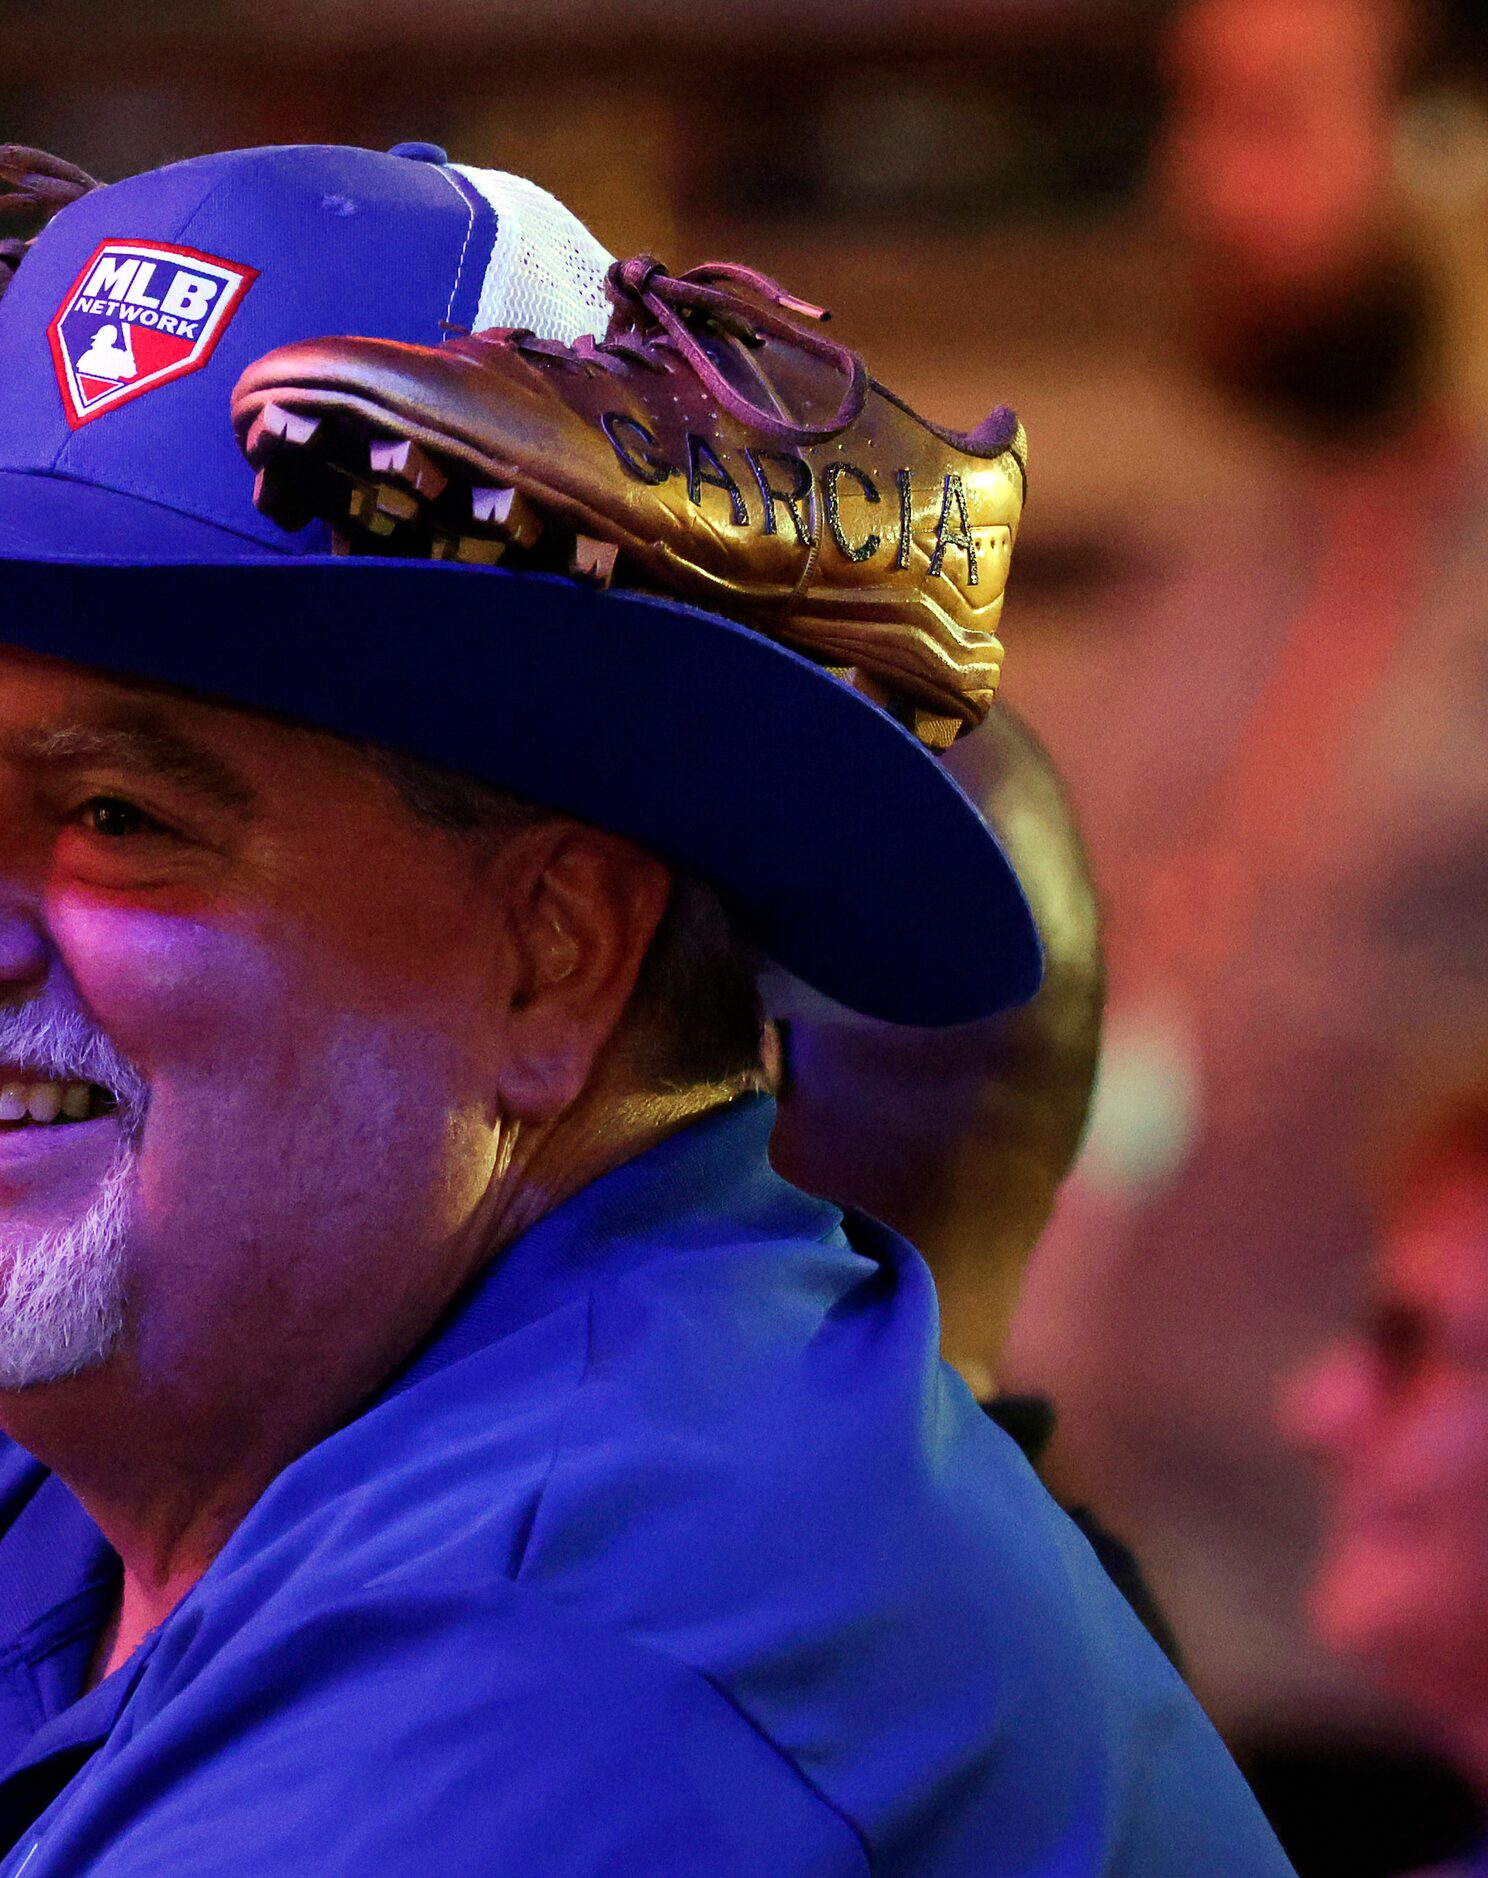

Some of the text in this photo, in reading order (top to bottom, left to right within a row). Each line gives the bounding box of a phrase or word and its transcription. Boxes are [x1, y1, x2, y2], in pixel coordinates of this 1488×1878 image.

[74, 297, 199, 339] NETWORK
[83, 257, 217, 321] MLB
[600, 411, 979, 586] GARCIA
